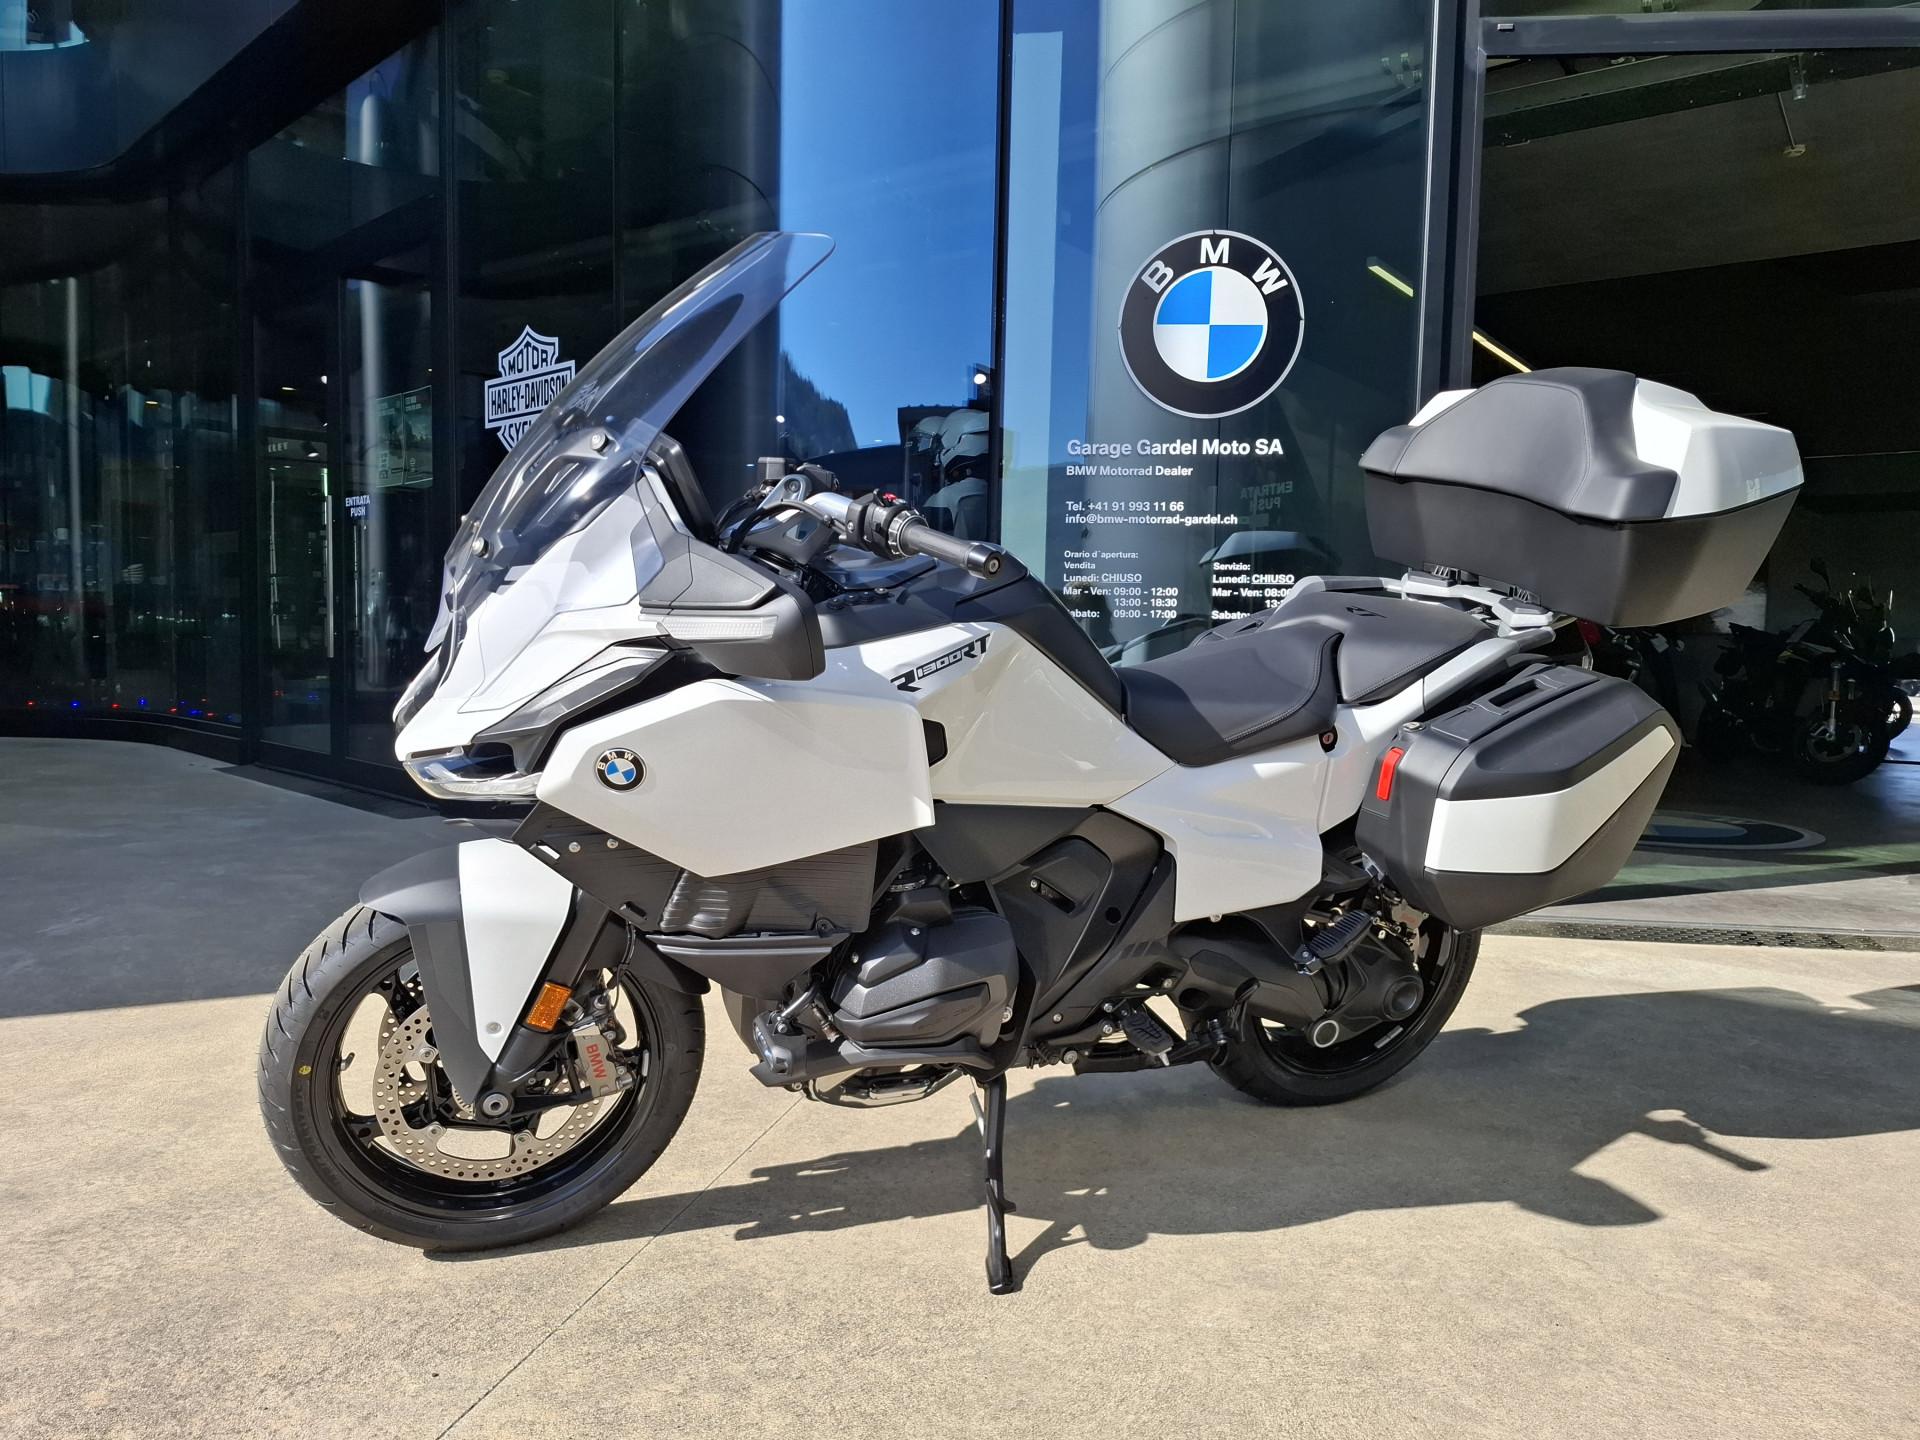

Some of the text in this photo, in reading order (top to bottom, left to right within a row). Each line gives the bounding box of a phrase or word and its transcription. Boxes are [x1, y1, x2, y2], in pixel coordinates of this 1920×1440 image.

[1141, 237, 1289, 296] BMW
[508, 340, 549, 376] MOTOR
[1067, 438, 1284, 459] Garage Gardel Moto SA
[1066, 465, 1193, 476] BMW Motorrad Dealer
[345, 495, 371, 507] ENTRATA
[1066, 501, 1185, 512] Tel. +41 91 993 11 66
[350, 506, 366, 517] PUSH
[1065, 514, 1238, 526] info@bmw-motorrad-gardel.ch
[1064, 550, 1090, 558] Orario
[1064, 561, 1096, 570] Vendita
[1213, 562, 1251, 571] Servizio:
[1101, 573, 1142, 583] CHIUSO
[1251, 574, 1295, 584] CHIUSO
[1063, 587, 1082, 595] Mar
[1090, 587, 1111, 595] Ven:
[1113, 587, 1141, 596] 09:00
[1150, 587, 1179, 596] 12:00
[1212, 588, 1232, 597] Mar
[1240, 588, 1262, 597] Ven:
[1114, 598, 1141, 607] 13:00
[1150, 598, 1178, 607] 18:30
[1068, 609, 1100, 618] abato:
[1113, 610, 1141, 618] 09:00
[1150, 610, 1177, 619] 17:00
[597, 751, 635, 771] BMW
[586, 1043, 608, 1079] BMW
